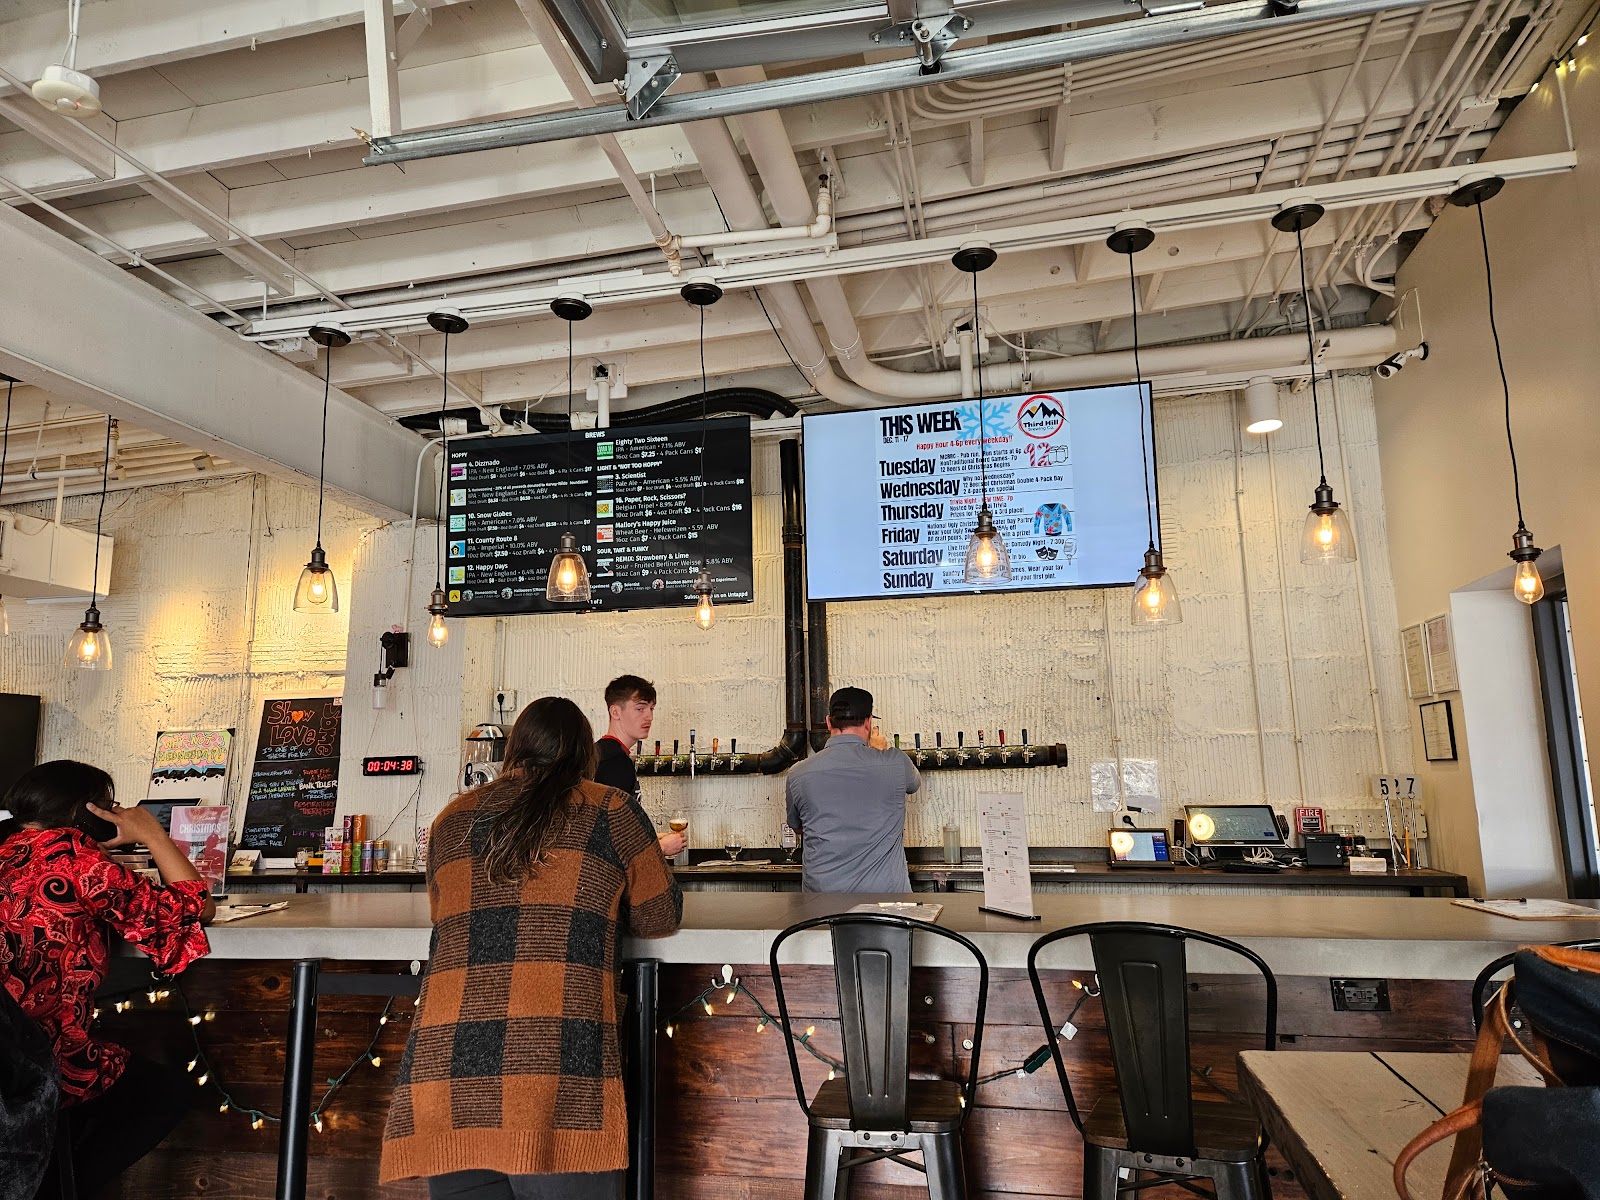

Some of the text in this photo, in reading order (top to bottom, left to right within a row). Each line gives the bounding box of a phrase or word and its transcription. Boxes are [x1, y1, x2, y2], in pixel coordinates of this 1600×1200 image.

[880, 410, 962, 436] THIS WEEK
[1024, 442, 1052, 466] 12
[879, 458, 936, 476] Tuesday
[880, 479, 960, 499] Wednesday
[881, 502, 944, 521] Thursday
[882, 527, 920, 543] Friday
[882, 548, 943, 567] Saturday
[884, 571, 933, 589] Sunday
[367, 760, 412, 771] 00:04:38
[316, 780, 338, 788] TELLER
[1380, 779, 1389, 795] 5
[1407, 778, 1414, 793] 7
[180, 823, 221, 833] CHRISTMAS
